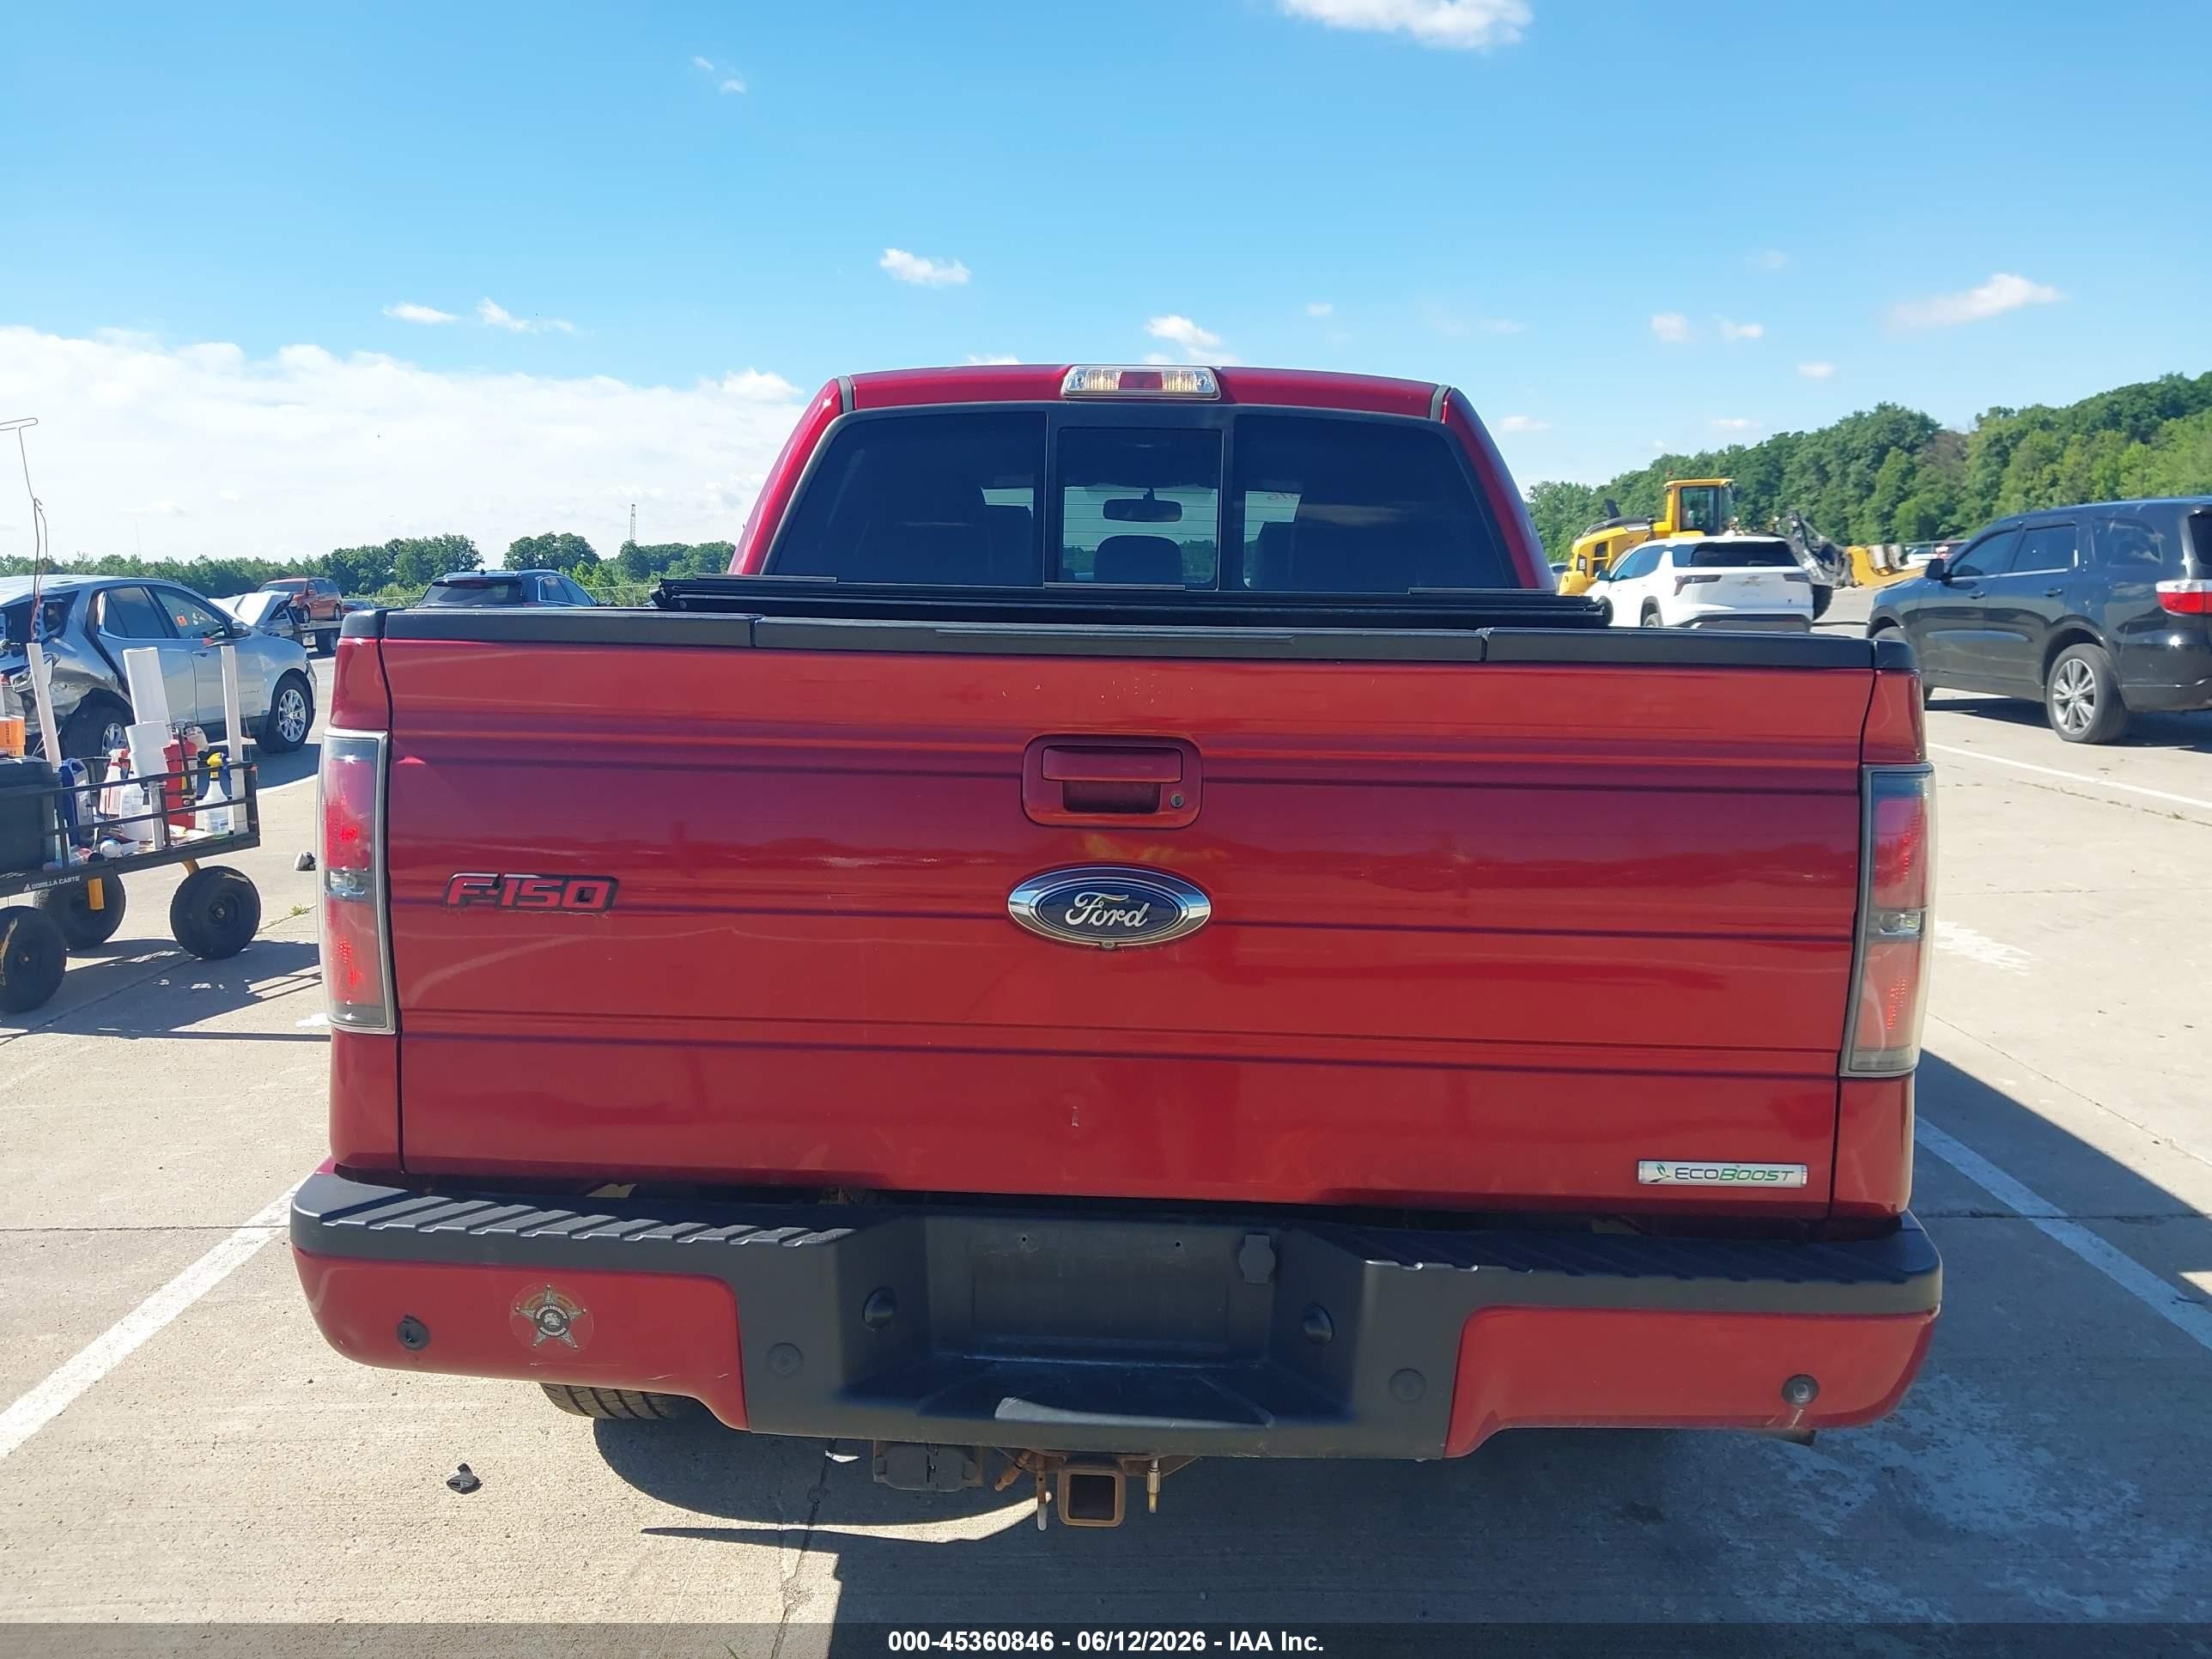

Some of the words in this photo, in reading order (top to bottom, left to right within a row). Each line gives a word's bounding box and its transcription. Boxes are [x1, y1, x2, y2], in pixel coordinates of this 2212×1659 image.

[31, 880, 58, 890] GORILLA
[444, 874, 616, 910] F-150
[1065, 891, 1151, 927] Ford
[1674, 1167, 1794, 1182] ECOBOOST
